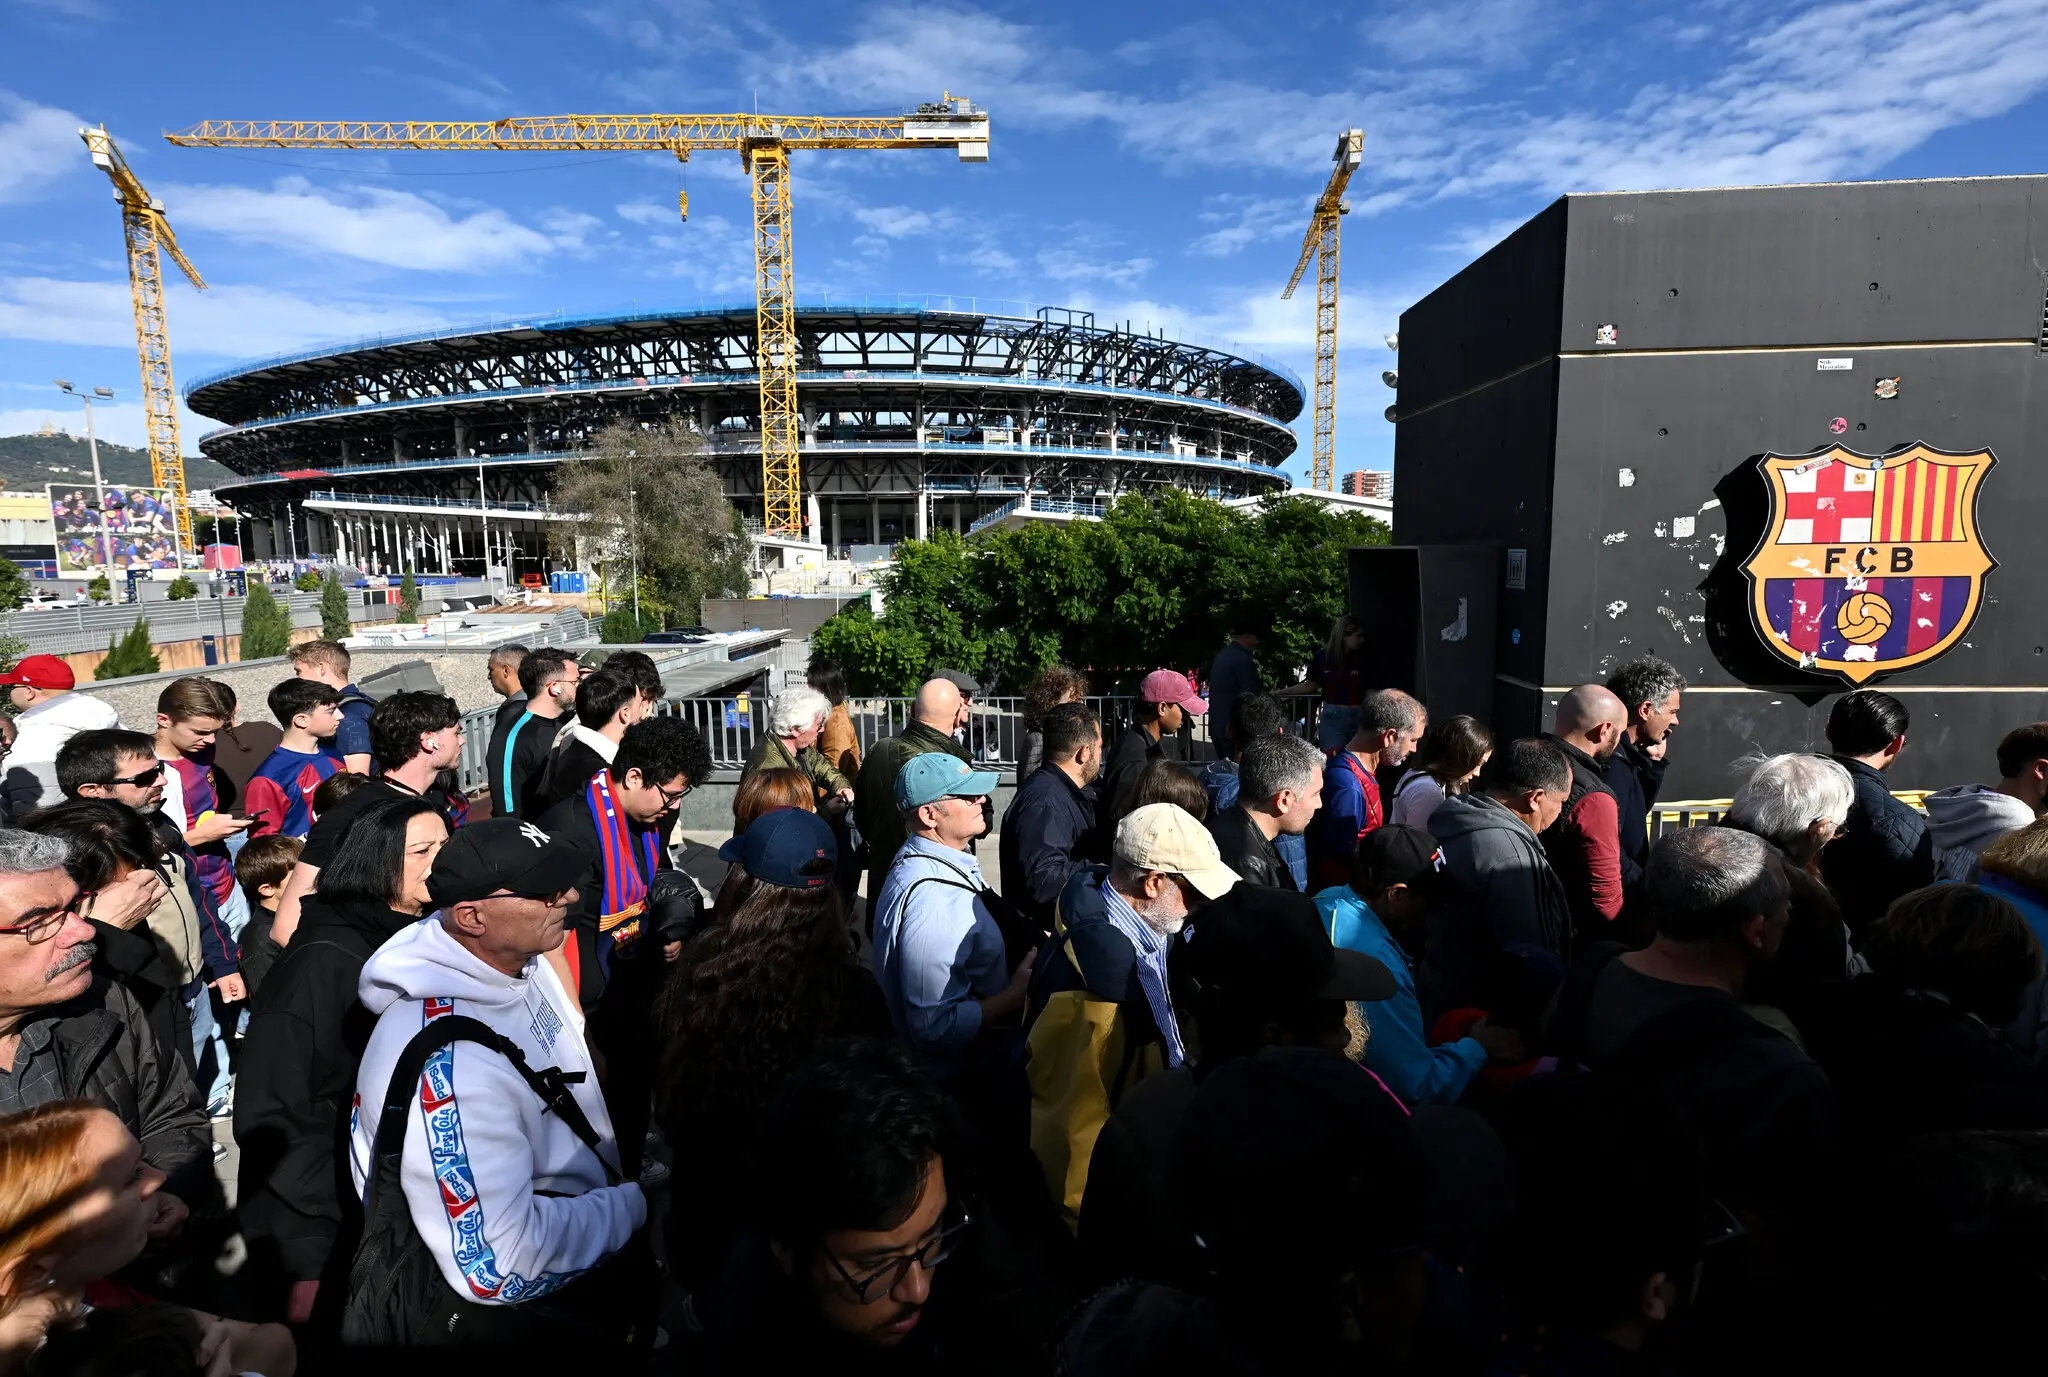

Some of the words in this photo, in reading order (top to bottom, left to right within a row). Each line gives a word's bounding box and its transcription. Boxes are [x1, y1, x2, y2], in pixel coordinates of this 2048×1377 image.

[1825, 546, 1914, 574] FCB
[519, 821, 551, 848] NY
[428, 1064, 449, 1100] PEPSI
[444, 1170, 472, 1203] PEPSI
